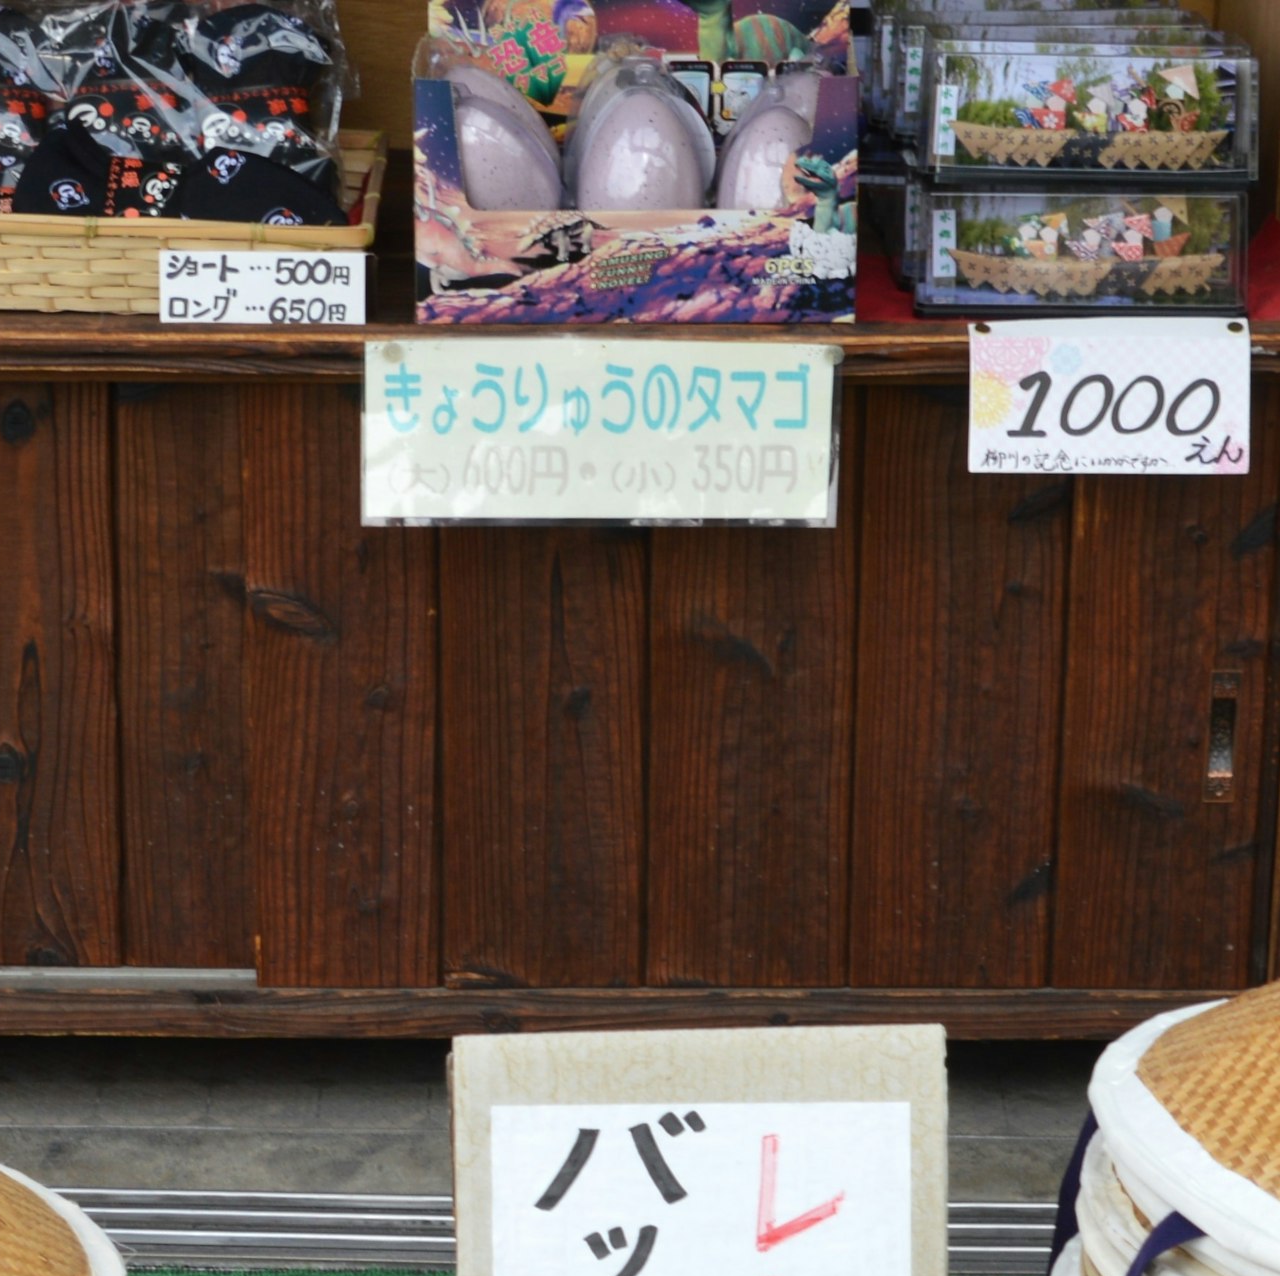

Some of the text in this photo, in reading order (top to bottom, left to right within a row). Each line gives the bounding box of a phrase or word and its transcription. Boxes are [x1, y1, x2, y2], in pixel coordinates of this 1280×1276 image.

[765, 257, 814, 275] 6PCS
[384, 363, 810, 435] きょうりゅうのタマゴ
